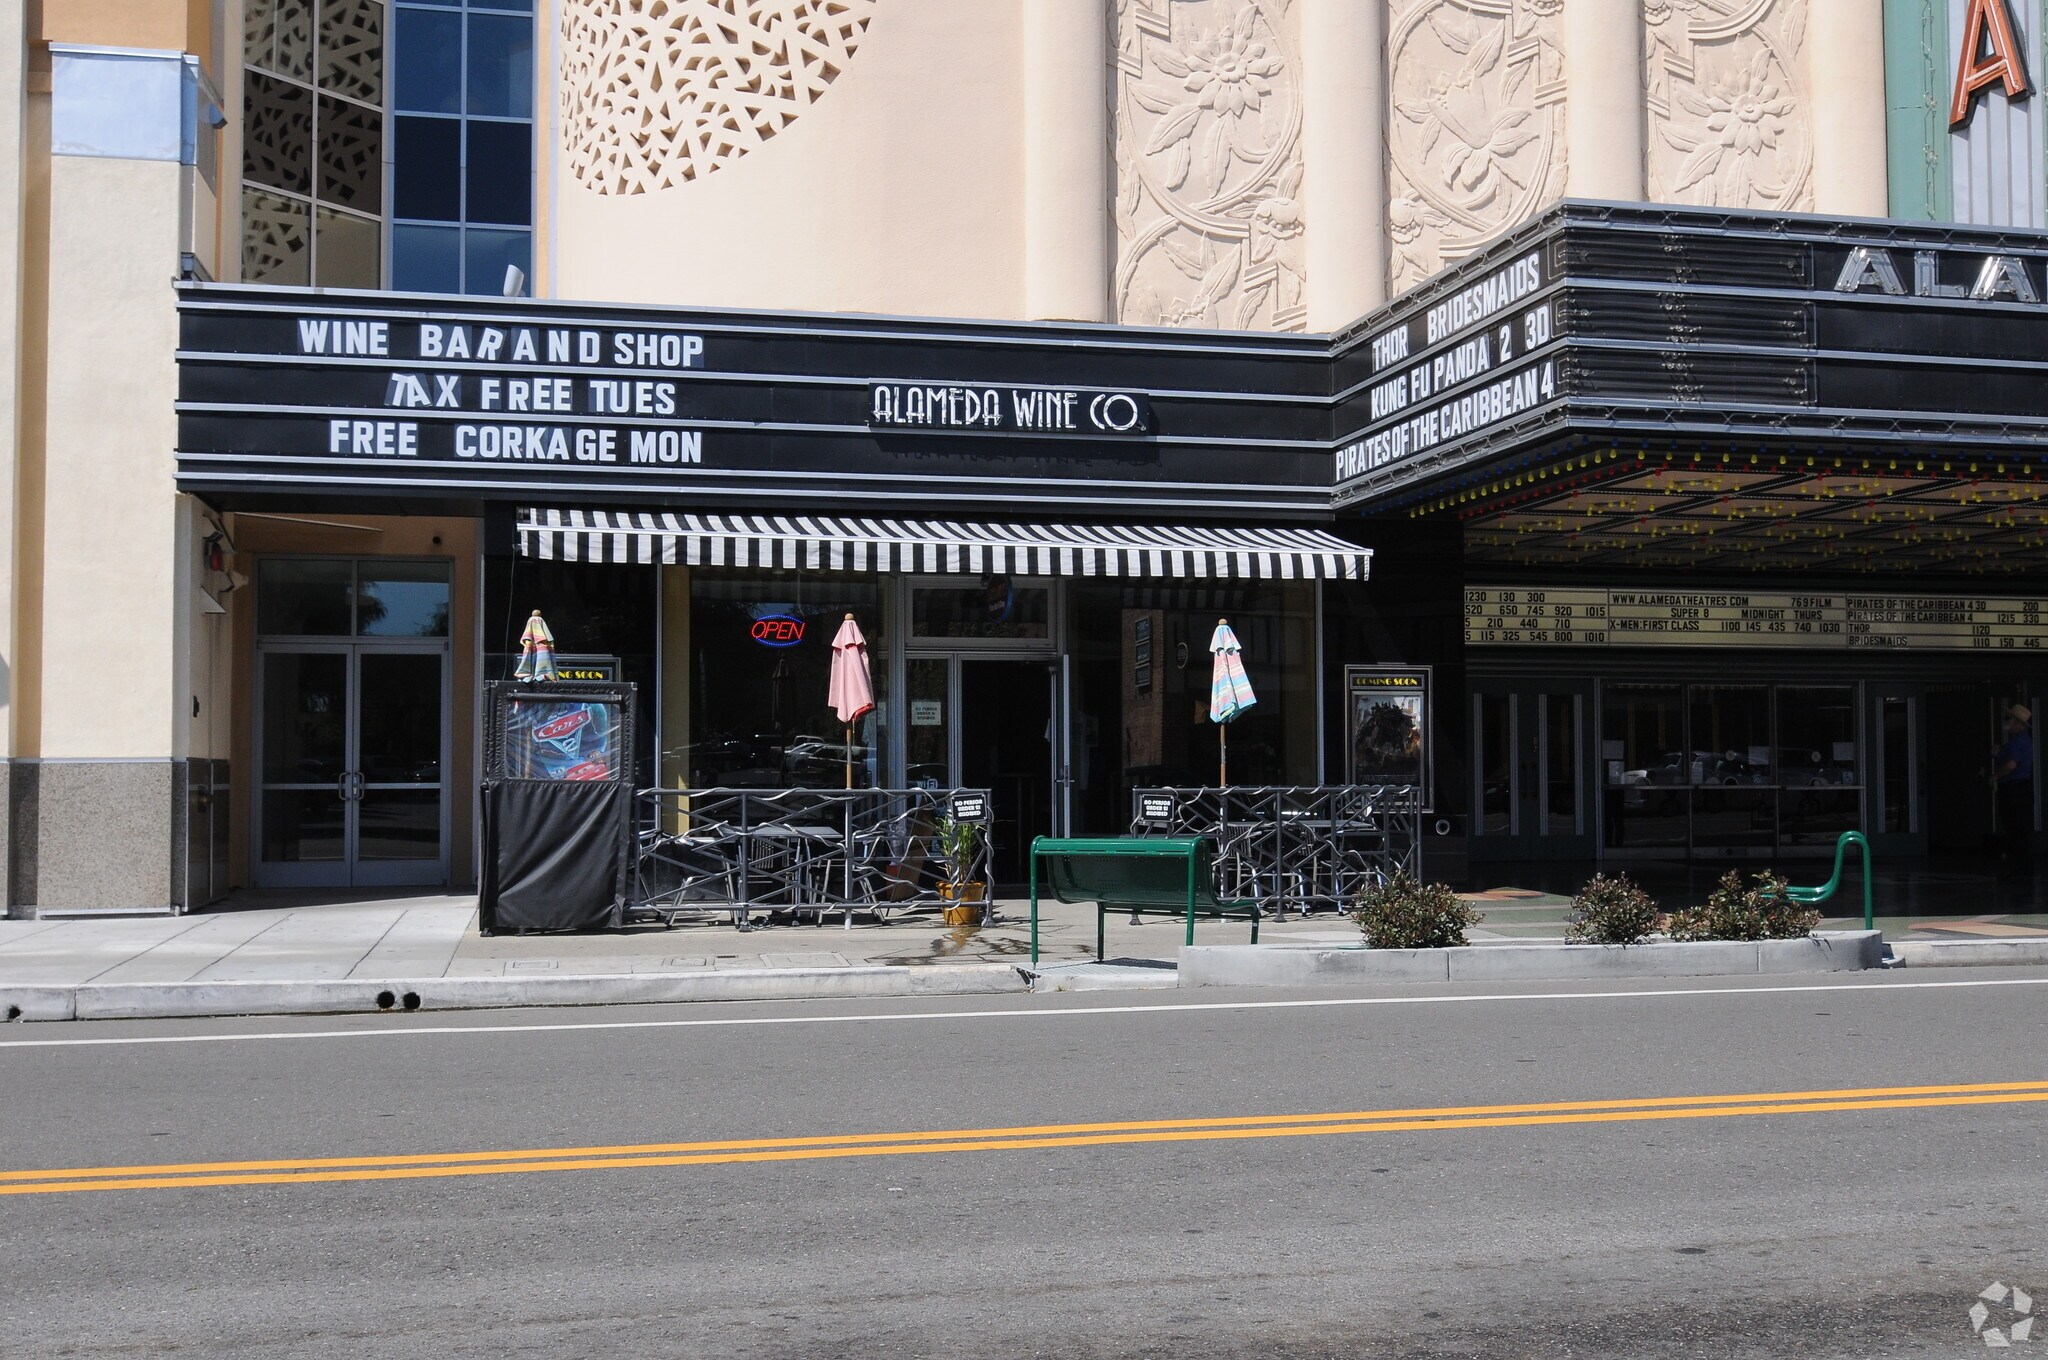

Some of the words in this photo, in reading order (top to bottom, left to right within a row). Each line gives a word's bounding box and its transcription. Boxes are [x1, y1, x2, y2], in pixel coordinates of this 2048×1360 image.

[1373, 325, 1408, 372] THOR
[1427, 253, 1539, 345] BRIDESMAIDS
[299, 320, 388, 356] WINE
[614, 335, 703, 368] SHOP
[1371, 375, 1407, 421] KUNG
[1411, 364, 1431, 403] FU
[1434, 335, 1490, 391] PANDA
[1501, 325, 1511, 362] 2
[1525, 306, 1549, 350] 3D
[391, 373, 459, 408] TAX
[481, 379, 572, 412] FREE
[590, 381, 676, 415] TUES
[874, 386, 1001, 426] ALAMEDA
[1012, 390, 1078, 429] WINE
[1090, 394, 1138, 430] CO
[1336, 430, 1391, 481] PIRATES
[1392, 423, 1409, 458] OF
[1411, 412, 1438, 451] THE
[1440, 368, 1537, 439] CARIBBEAN
[1541, 362, 1553, 399] 4
[331, 421, 417, 456] FREE
[455, 426, 616, 462] CORKAGE
[631, 431, 702, 463] MON
[1465, 592, 1487, 602] 1230
[1499, 592, 1515, 602] 130
[1527, 593, 1545, 602] 300
[1612, 594, 1636, 604] WWW
[1638, 595, 1727, 606] ALAMEDATHEATRES
[1730, 597, 1749, 606] COM
[1465, 605, 1483, 614] 520
[1499, 605, 1518, 615] 650
[1527, 605, 1544, 615] 745
[1554, 606, 1572, 616] 920
[1586, 607, 1605, 616] 1015
[1847, 599, 1884, 609] PIRATES
[1886, 600, 1897, 609] OF
[1900, 600, 1915, 609] THE
[1917, 600, 1965, 610] CARIBBEAN
[2023, 602, 2039, 611] 200
[1671, 608, 1699, 618] SUPER
[1703, 608, 1709, 618] 8
[1741, 609, 1785, 619] MIDNIGHT
[1794, 610, 1822, 620] THURS
[1848, 611, 1884, 621] PIRATES
[1886, 612, 1897, 621] OF
[1900, 612, 1915, 621] THE
[1917, 612, 1966, 622] CARIBBEAN
[1967, 613, 1973, 622] 4
[1998, 614, 2015, 623] 1215
[2023, 614, 2039, 623] 330
[1487, 618, 1503, 628] 210
[1520, 618, 1538, 628] 440
[1555, 619, 1570, 628] 710
[1671, 621, 1700, 630] CLASS
[1721, 622, 1740, 631] 1100
[1746, 622, 1761, 631] 145
[1768, 622, 1785, 631] 435
[1794, 623, 1811, 632] 740
[1819, 623, 1840, 632] 1030
[751, 621, 806, 640] OPEN
[1849, 624, 1870, 633] THOR
[1973, 625, 1990, 635] 1120
[1481, 631, 1495, 640] 115
[1502, 631, 1520, 641] 325
[1530, 631, 1547, 641] 545
[1554, 632, 1572, 641] 800
[1585, 632, 1604, 642] 1010
[1849, 636, 1907, 646] BRIDESMAIDS
[1974, 638, 1990, 647] 1110
[2000, 638, 2014, 648] 150
[2024, 638, 2040, 648] 445
[575, 671, 603, 679] SOON
[1356, 678, 1392, 686] COMING
[1393, 678, 1418, 686] SOON
[538, 715, 585, 738] Cars
